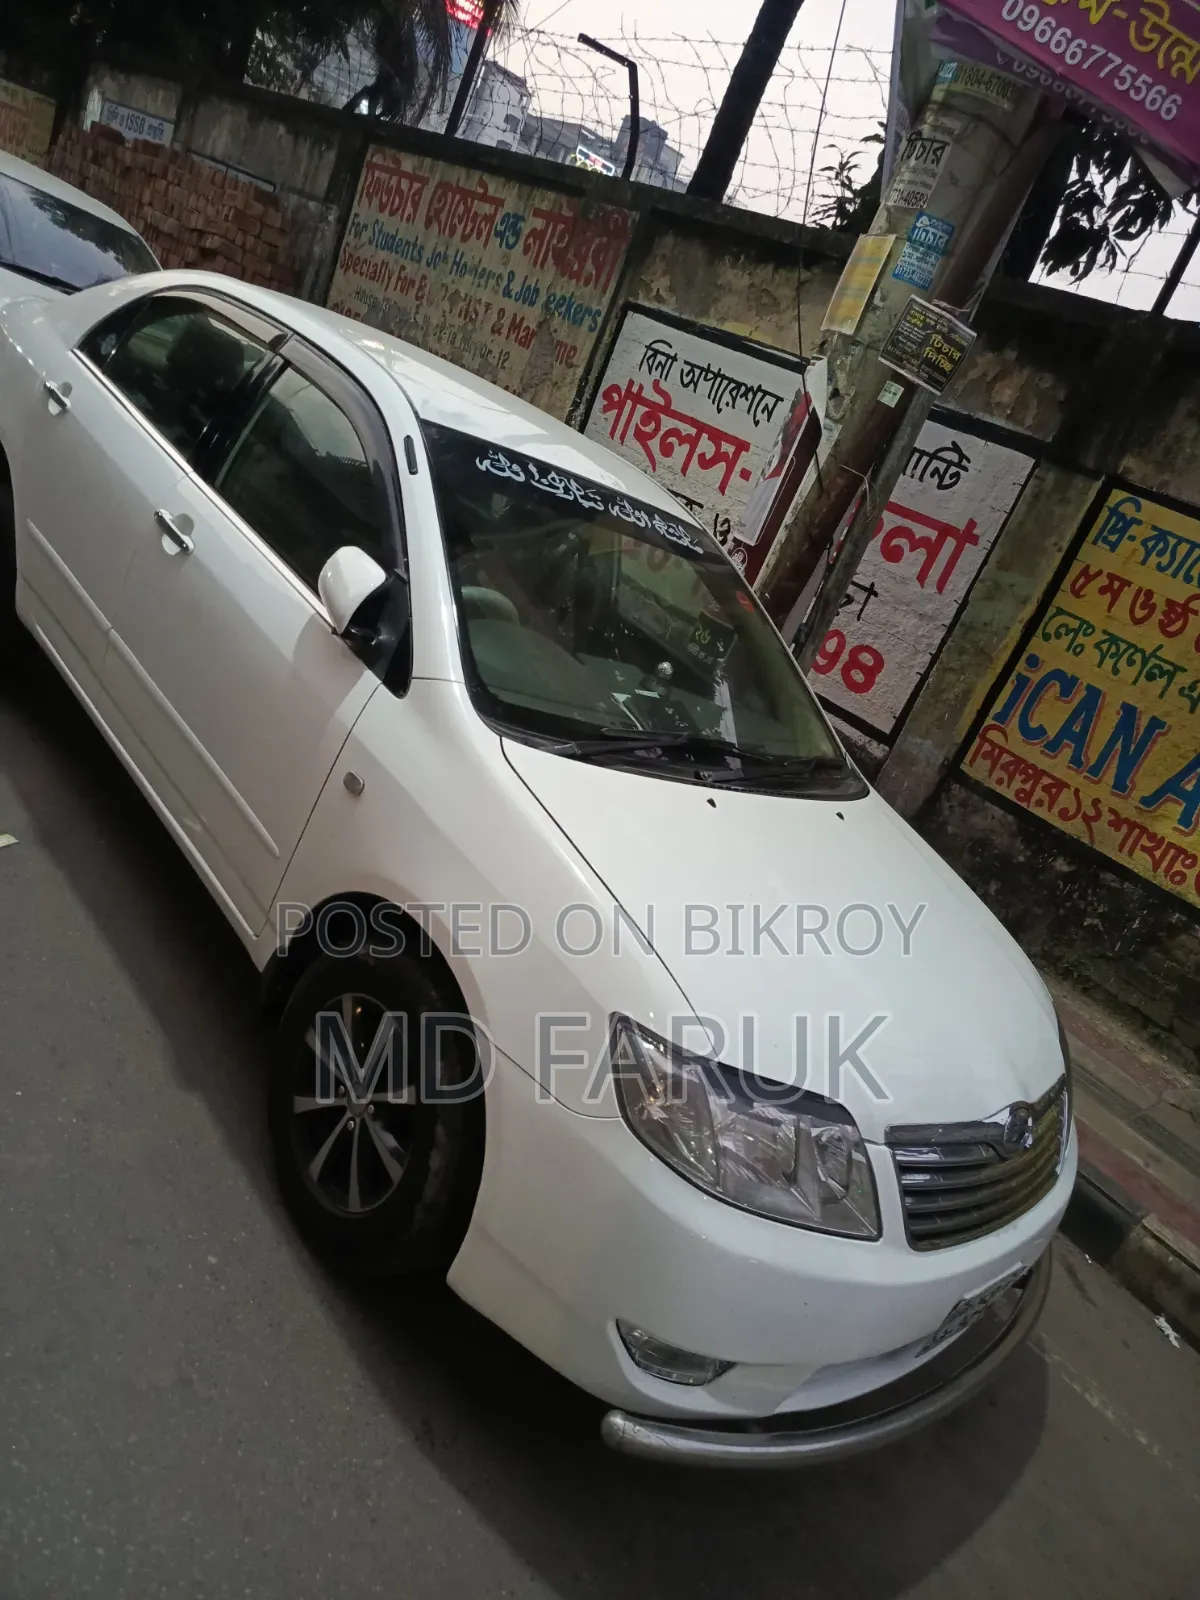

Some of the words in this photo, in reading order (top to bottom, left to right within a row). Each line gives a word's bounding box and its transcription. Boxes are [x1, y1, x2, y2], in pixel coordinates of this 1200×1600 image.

[1002, 0, 1182, 121] 09666775566
[125, 110, 146, 136] ISSB
[339, 243, 393, 292] Specially
[393, 264, 416, 293] For
[350, 211, 369, 240] For
[369, 220, 424, 265] Students
[514, 274, 539, 306] Job
[638, 340, 679, 382] বিনা
[679, 360, 785, 428] অপারেশনে
[968, 723, 1071, 808] মিরপুর
[992, 652, 1171, 796] iCAN
